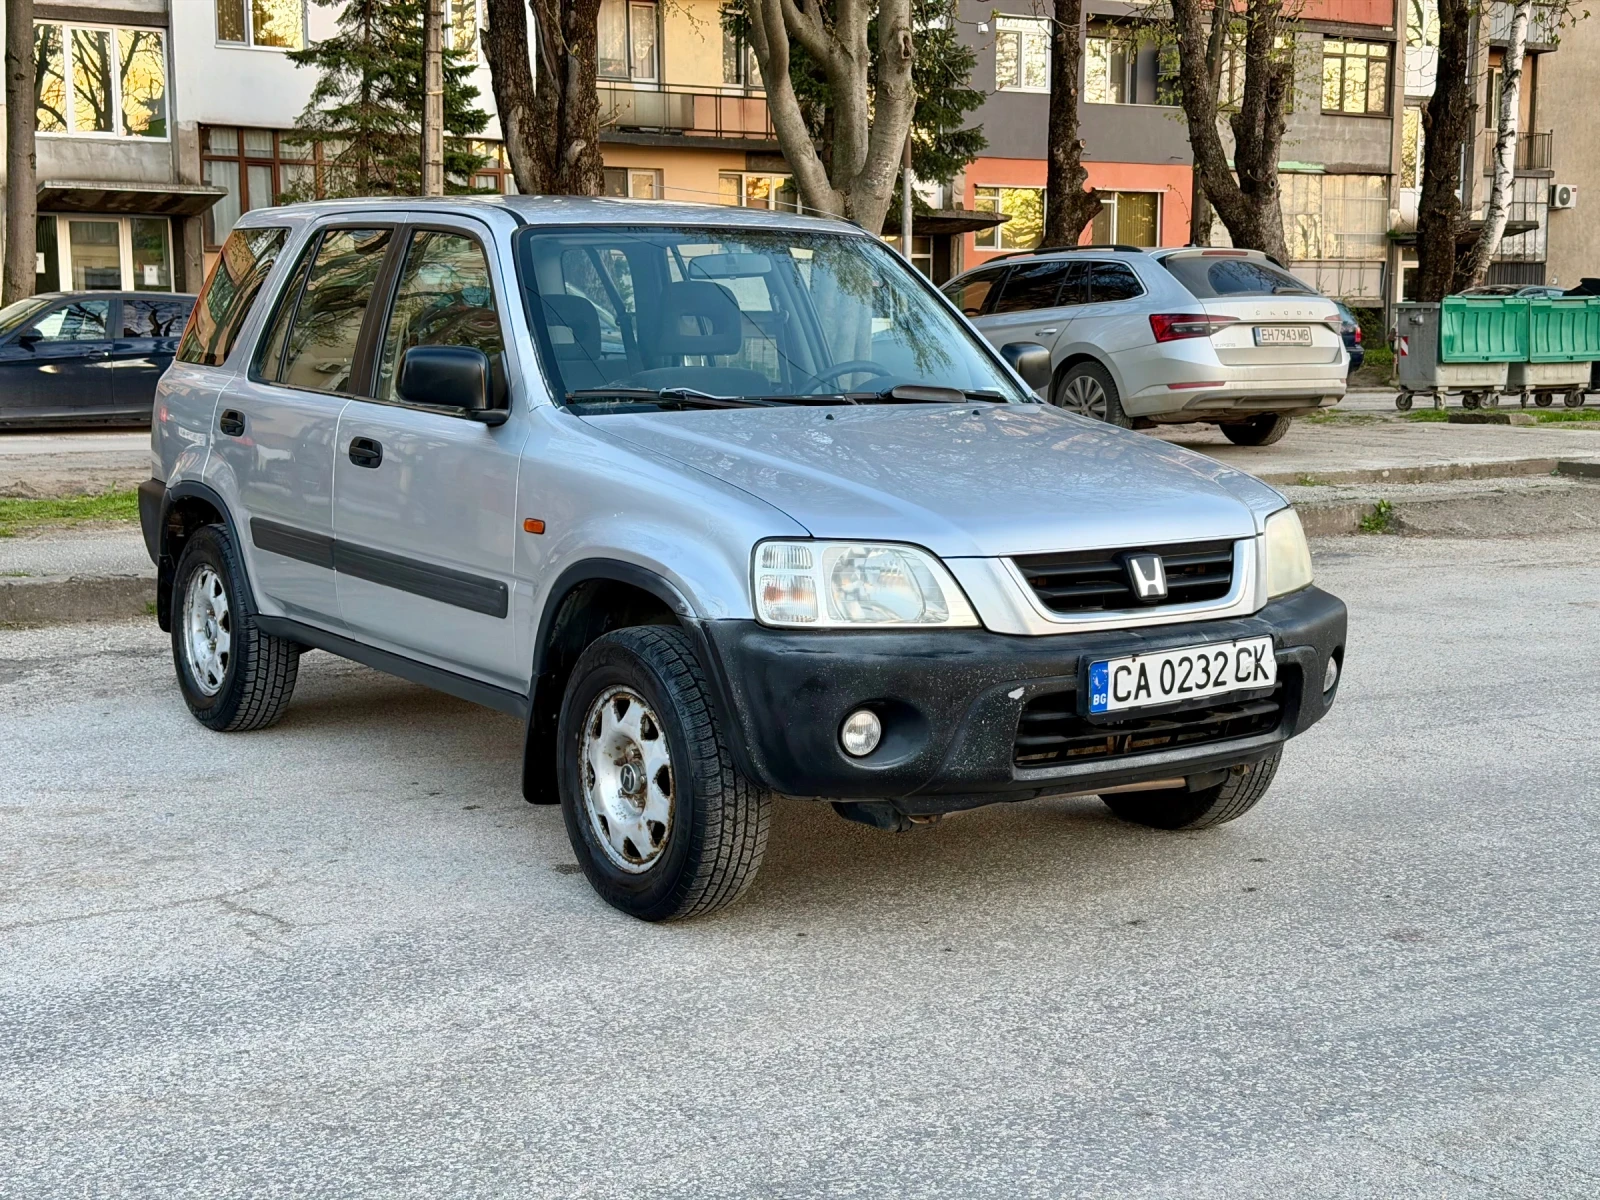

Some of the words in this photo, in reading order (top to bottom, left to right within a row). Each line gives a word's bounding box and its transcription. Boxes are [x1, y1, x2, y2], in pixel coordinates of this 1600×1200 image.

[1113, 662, 1151, 702] CA
[1160, 651, 1228, 695] 0232
[1235, 644, 1269, 682] CK
[1093, 693, 1107, 705] BG
